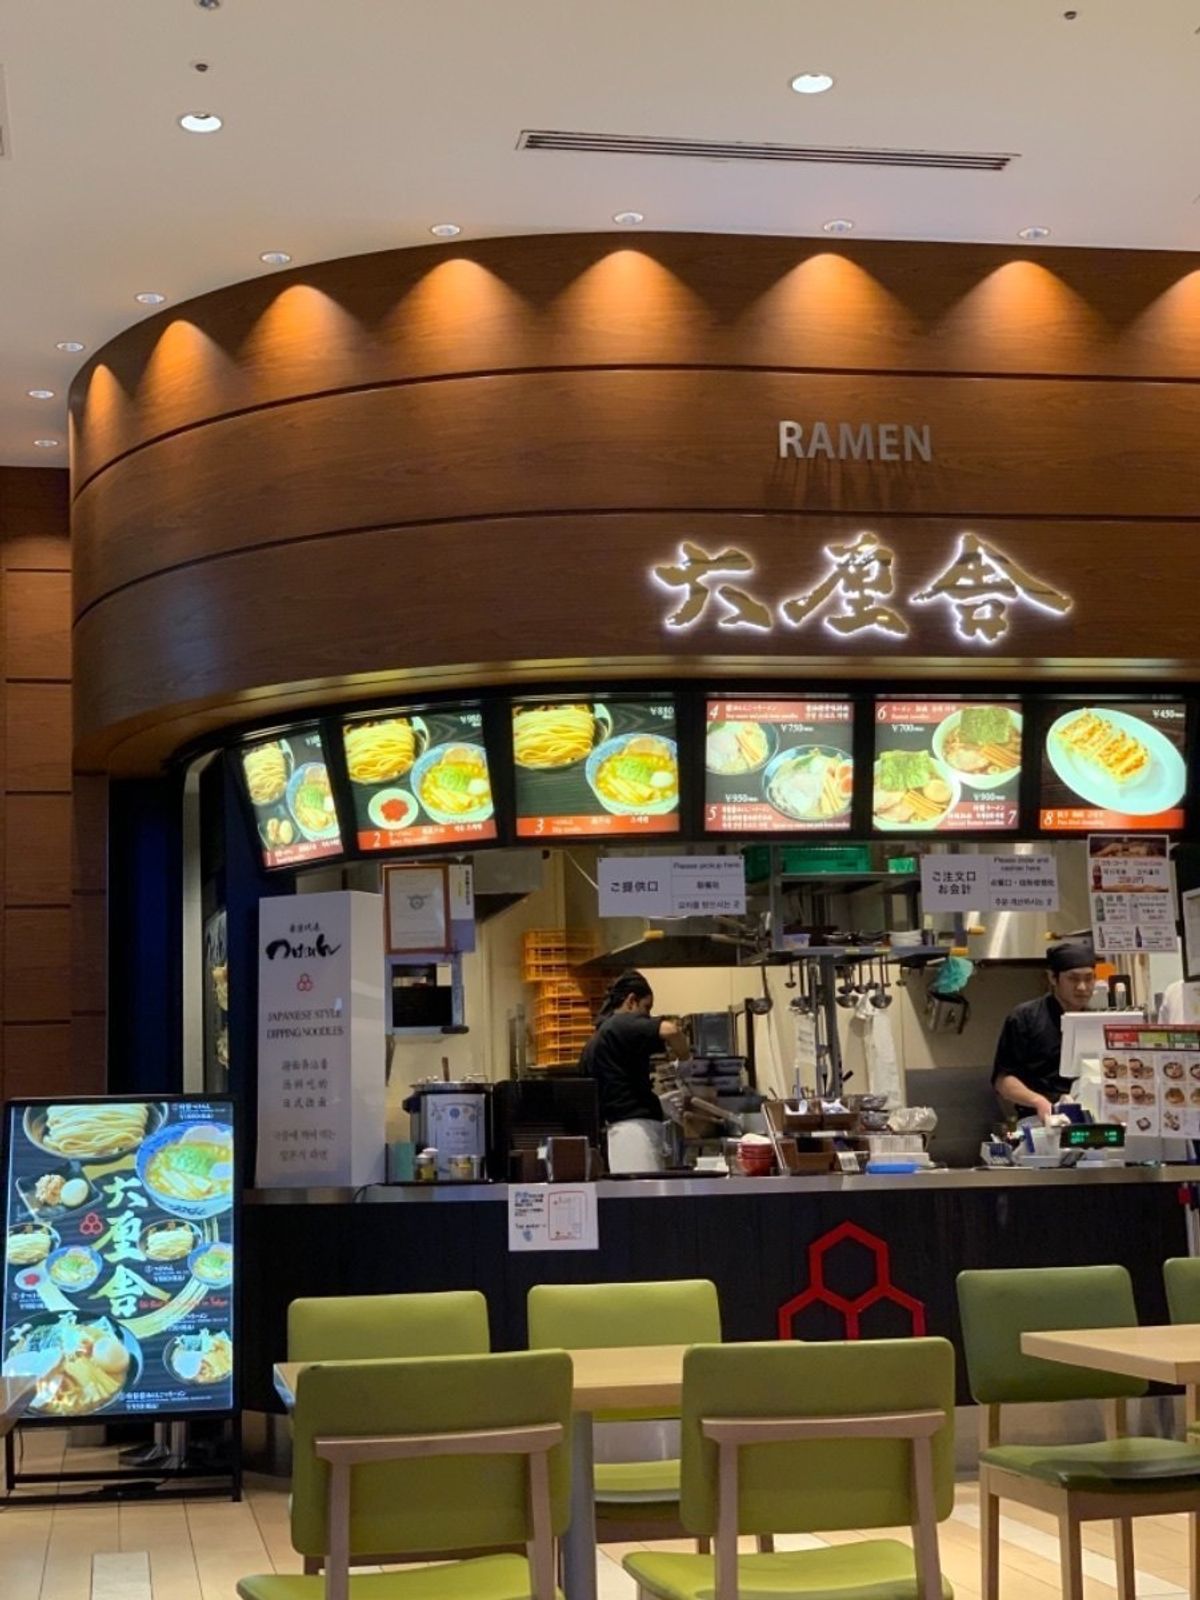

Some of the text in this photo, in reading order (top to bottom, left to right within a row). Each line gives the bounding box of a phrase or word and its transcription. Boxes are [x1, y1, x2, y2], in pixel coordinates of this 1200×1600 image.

[778, 420, 932, 463] RAMEN
[709, 704, 719, 719] 4
[877, 705, 887, 720] 6
[708, 806, 717, 821] 5
[1008, 810, 1017, 825] 7
[1043, 811, 1053, 826] 8
[534, 818, 544, 834] 3
[372, 831, 381, 848] 2
[673, 862, 698, 870] Please
[724, 861, 741, 869] here
[993, 856, 1017, 864] Please
[932, 871, 976, 882] ご注文口
[610, 880, 659, 893] ご提供口
[938, 884, 971, 895] お会計
[267, 1007, 342, 1022] JAPANESE STYLE
[266, 1025, 345, 1040] DIPPING NOODLES
